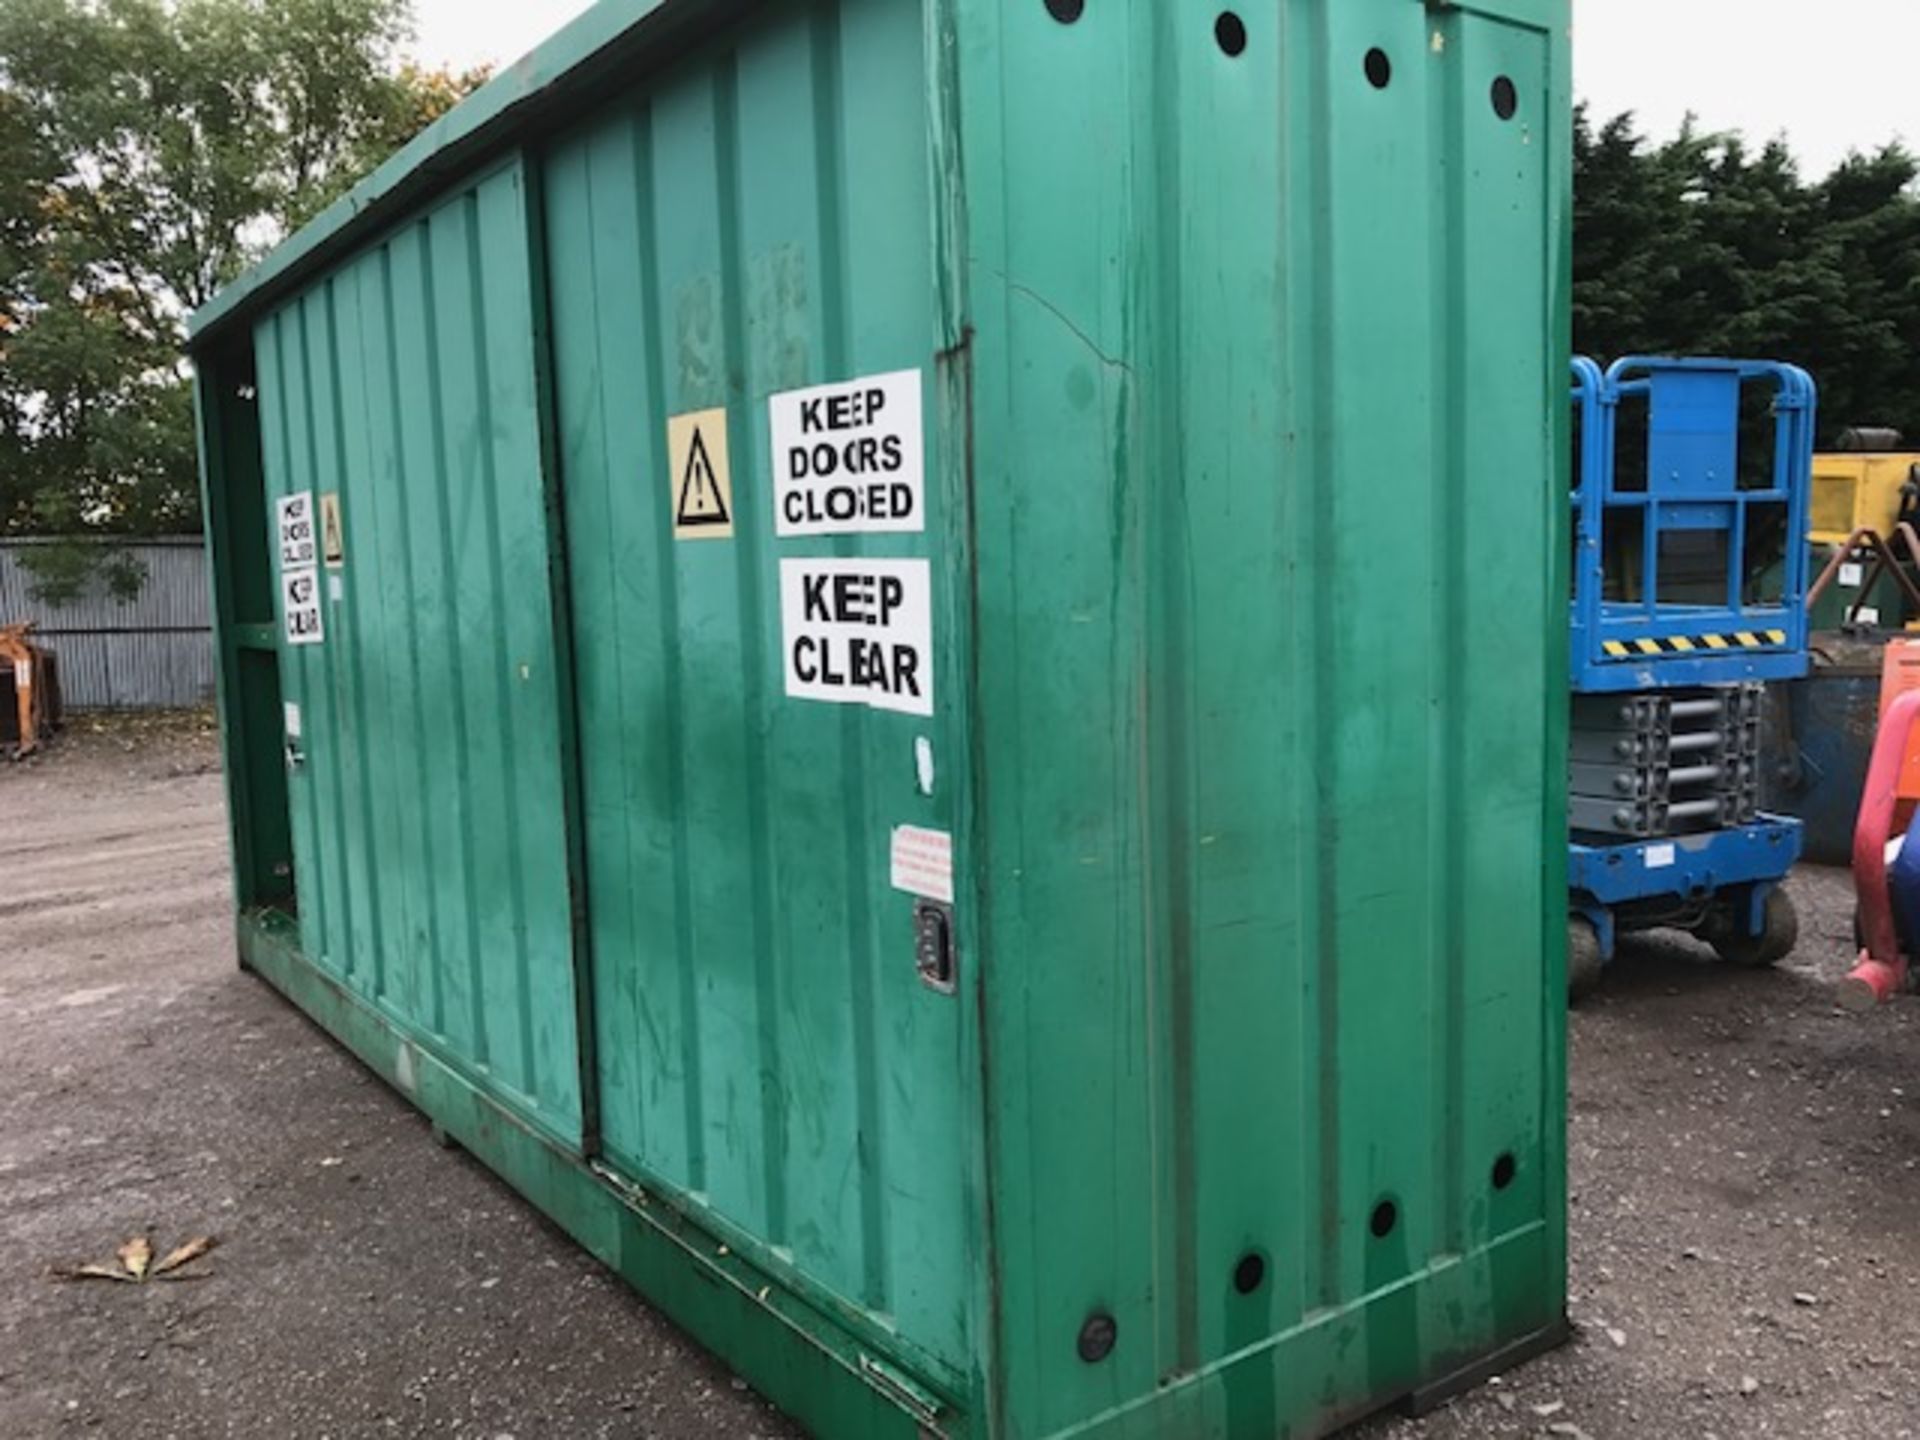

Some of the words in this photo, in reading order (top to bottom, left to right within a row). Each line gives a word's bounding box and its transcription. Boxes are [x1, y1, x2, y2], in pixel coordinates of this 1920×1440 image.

[800, 388, 886, 434] KEEP
[802, 574, 904, 627] KEEP
[792, 635, 921, 696] CLEAR
